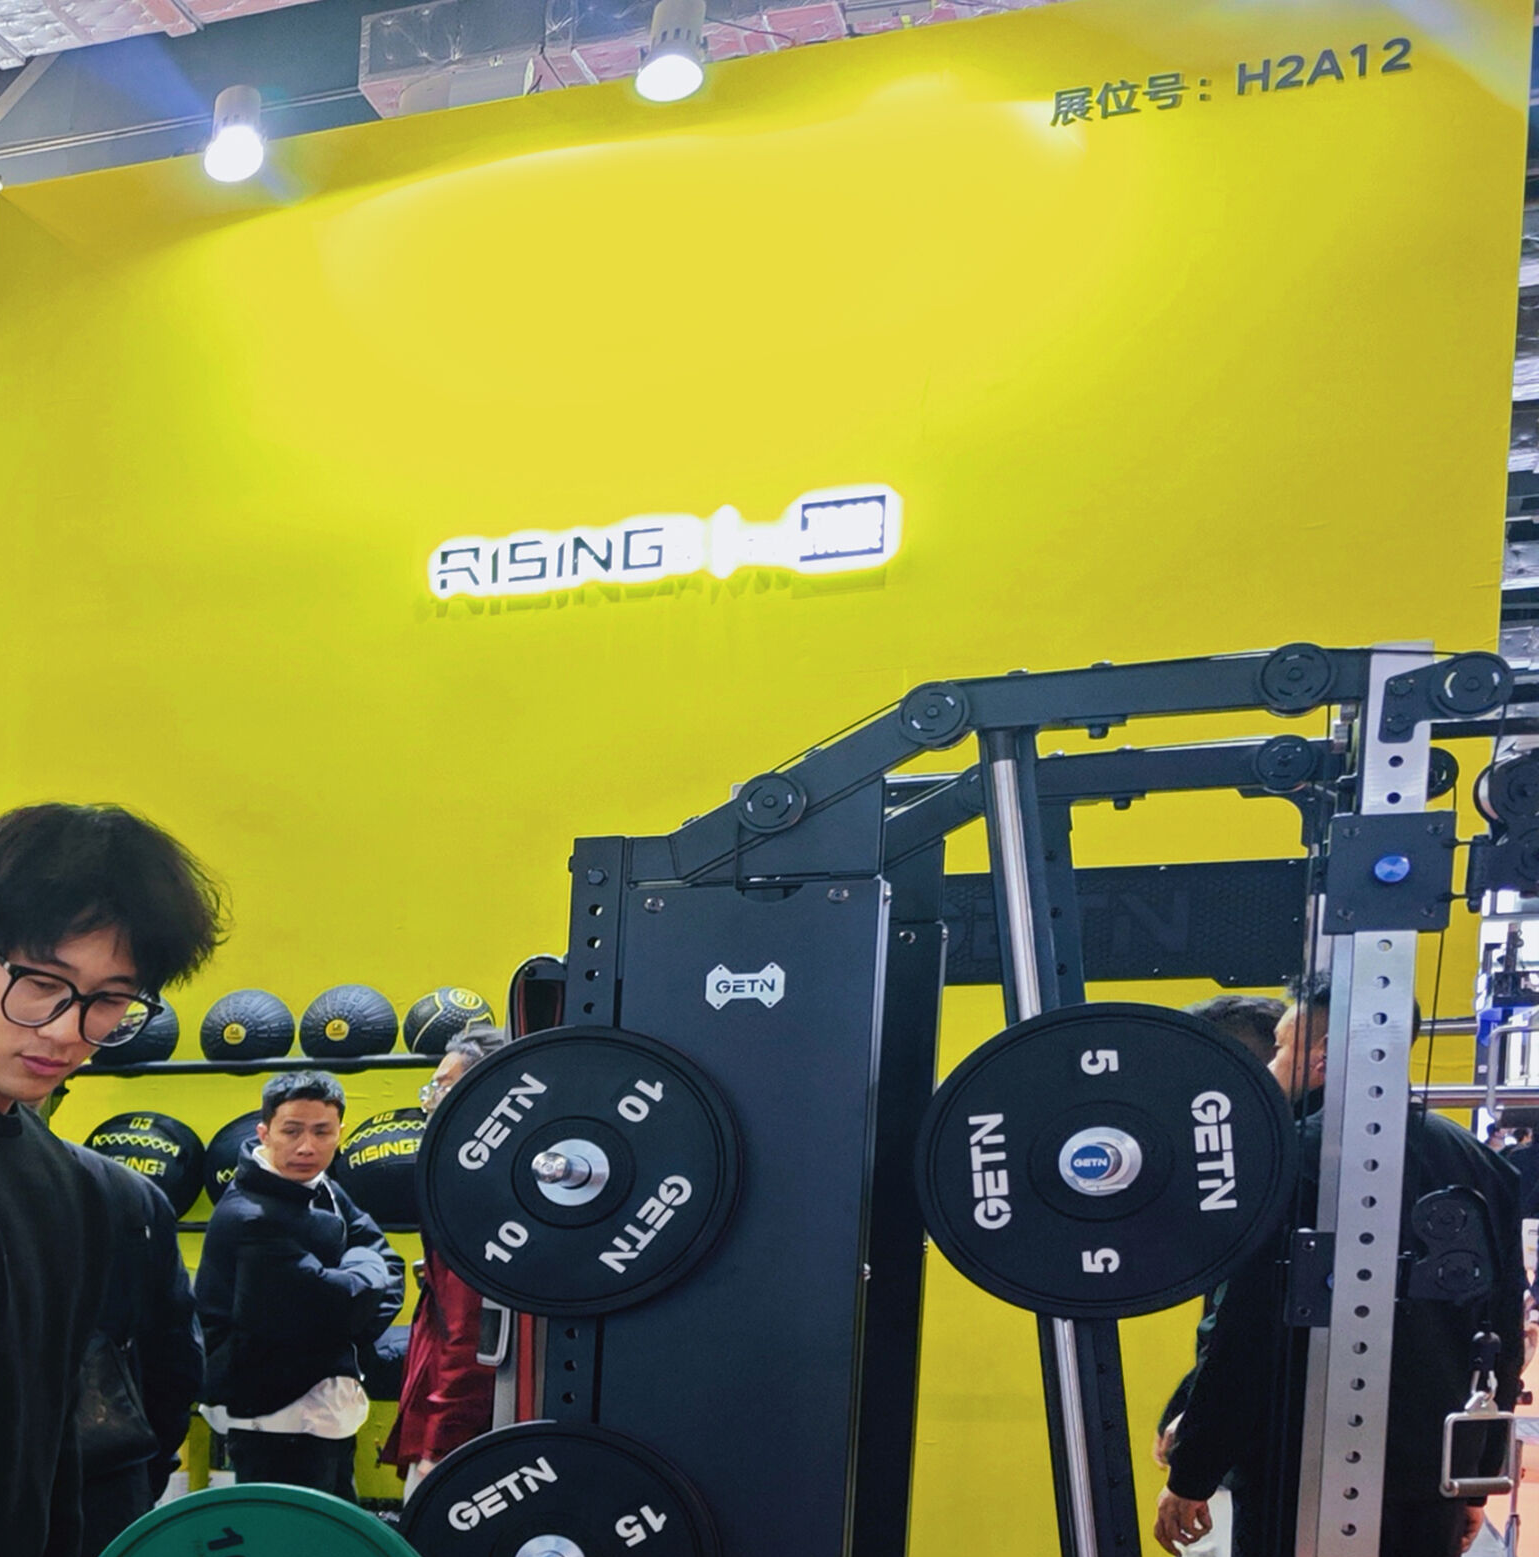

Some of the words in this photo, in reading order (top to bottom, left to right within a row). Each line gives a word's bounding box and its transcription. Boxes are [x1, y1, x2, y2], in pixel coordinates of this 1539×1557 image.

[436, 525, 665, 592] RISING
[715, 977, 776, 996] GETN
[1080, 1048, 1120, 1075] 5
[458, 1072, 549, 1171] GETN
[617, 1079, 665, 1124] 10
[130, 1117, 154, 1132] 03
[348, 1139, 414, 1171] RISING
[968, 1113, 1012, 1231] GETN
[1073, 1155, 1109, 1169] GETN
[1191, 1090, 1238, 1212] GETN
[484, 1220, 530, 1264] 10
[598, 1174, 693, 1275] GETN
[1081, 1247, 1121, 1274] 5
[447, 1456, 559, 1532] GETN
[614, 1504, 668, 1548] 15
